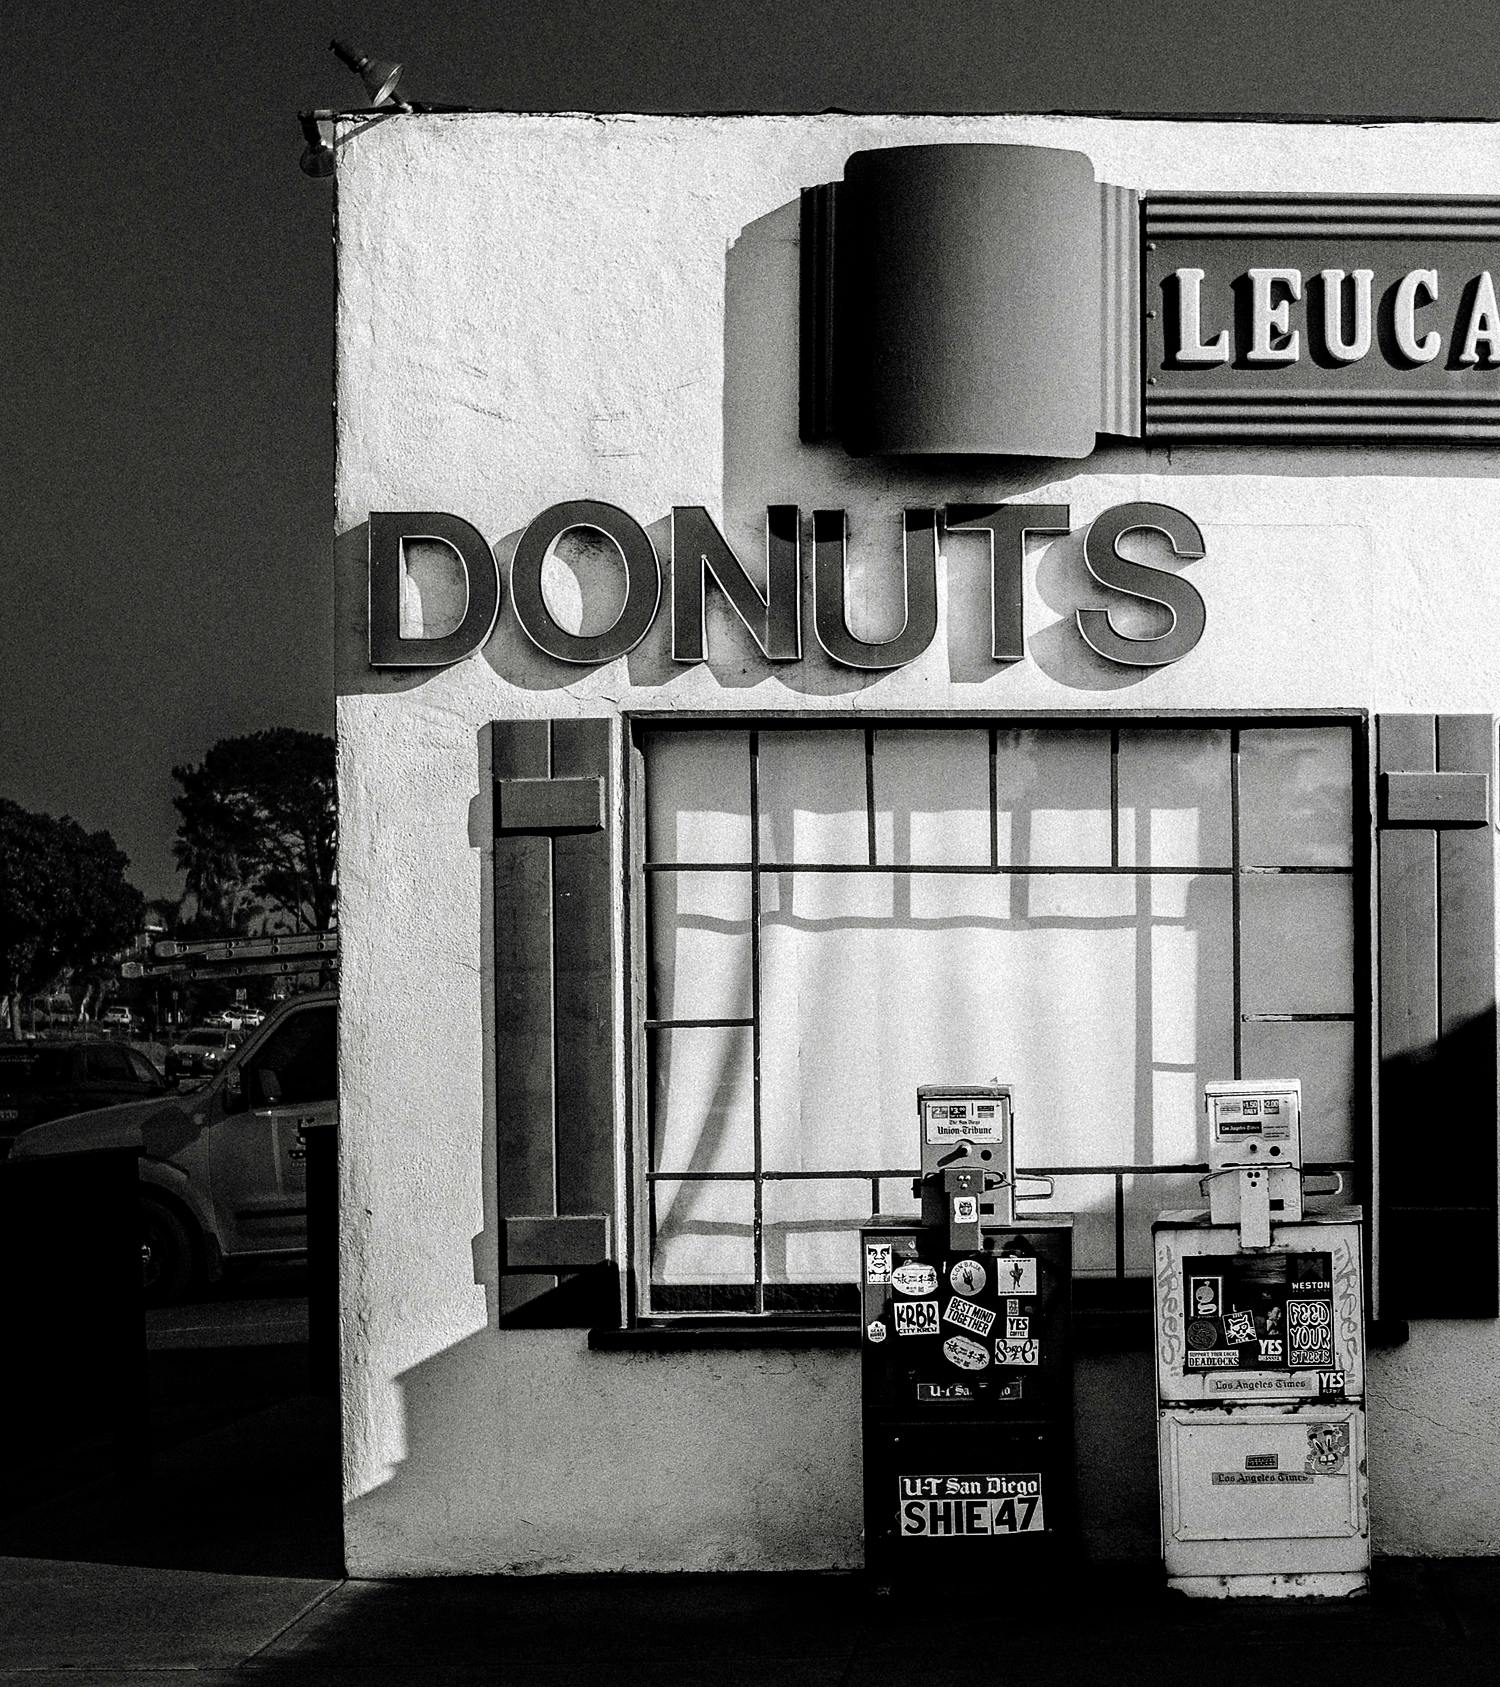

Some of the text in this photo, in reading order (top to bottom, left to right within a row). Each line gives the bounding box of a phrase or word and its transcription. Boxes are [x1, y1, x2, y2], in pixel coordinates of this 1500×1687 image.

[368, 499, 1206, 668] DONUTS
[937, 1125, 992, 1135] Union-Tribune
[1291, 1281, 1331, 1290] WESTON
[896, 1302, 938, 1329] KRBR
[950, 1297, 974, 1315] BEST
[971, 1305, 995, 1325] MIND
[1289, 1301, 1330, 1326] FEED
[947, 1307, 990, 1335] TOGETHER
[1007, 1317, 1028, 1331] YES
[1289, 1325, 1331, 1350] YOUR
[1258, 1339, 1283, 1355] YES
[1189, 1356, 1240, 1367] DEADLOCKS
[1290, 1349, 1331, 1364] STREETS
[1215, 1379, 1306, 1391] Los Angeles Times
[1319, 1372, 1344, 1388] YES
[954, 1384, 972, 1396] Sa
[1218, 1472, 1309, 1484] Los Angeles Times
[903, 1476, 1038, 1497] U-T San Diego
